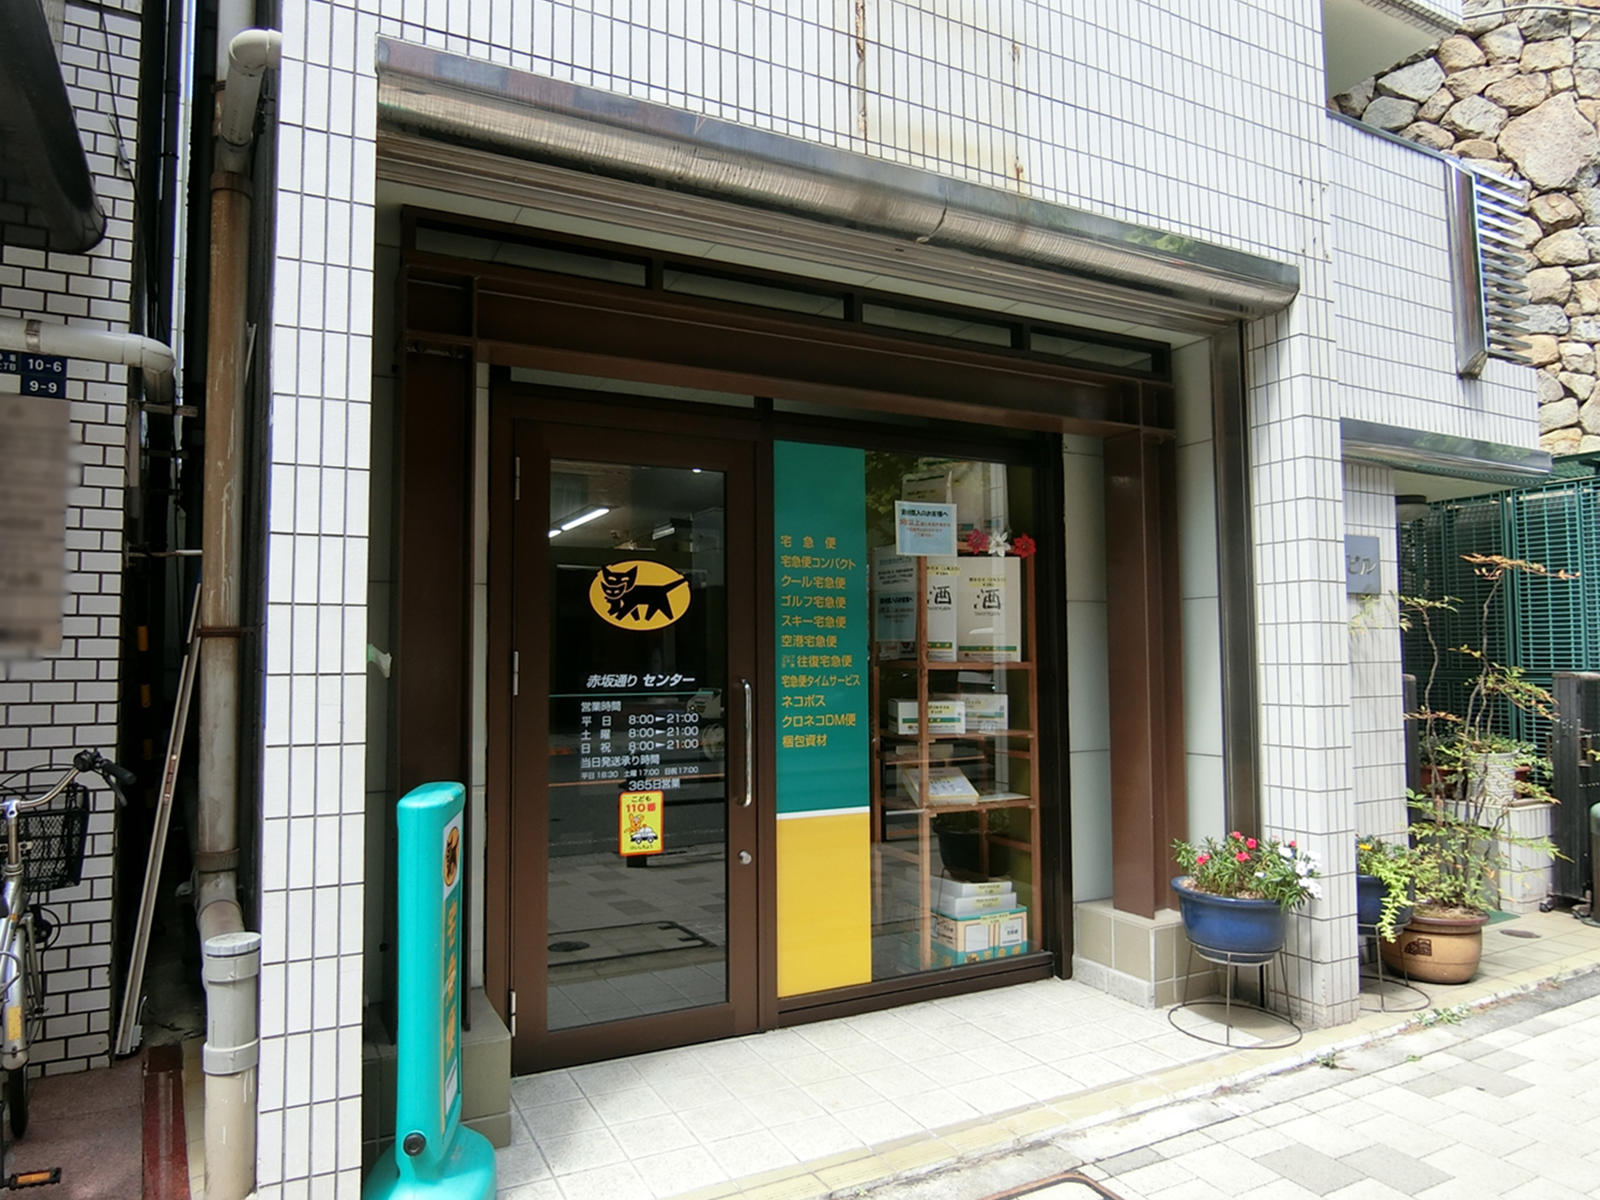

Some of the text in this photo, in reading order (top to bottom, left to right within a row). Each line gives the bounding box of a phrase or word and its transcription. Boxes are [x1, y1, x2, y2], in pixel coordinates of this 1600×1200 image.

[27, 358, 63, 373] 10-6
[29, 380, 58, 394] 9-9
[780, 535, 836, 550] 宅急便
[780, 554, 856, 571] 宅急便コンパクト
[781, 574, 846, 590] クール宅急便
[781, 594, 846, 609] ゴルフ宅急便
[926, 585, 952, 606] 酒
[973, 588, 1002, 610] 酒
[781, 614, 846, 629] スキー宅急便
[781, 633, 837, 648] 空港宅急便
[586, 673, 696, 688] 赤坂通り センター
[781, 674, 860, 688] 宅急便タイムサービス
[581, 701, 621, 712] 営業時間
[628, 714, 654, 725] 8:00
[666, 713, 699, 724] 21:00
[782, 713, 856, 728] クロネコDM便
[628, 727, 654, 738] 8:00
[666, 726, 699, 737] 21:00
[628, 740, 654, 751] 8:00
[666, 739, 699, 749] 21:00
[782, 734, 827, 748] 梱包資材
[581, 754, 660, 768] 当日発送承り時間
[628, 778, 681, 791] 365日営業
